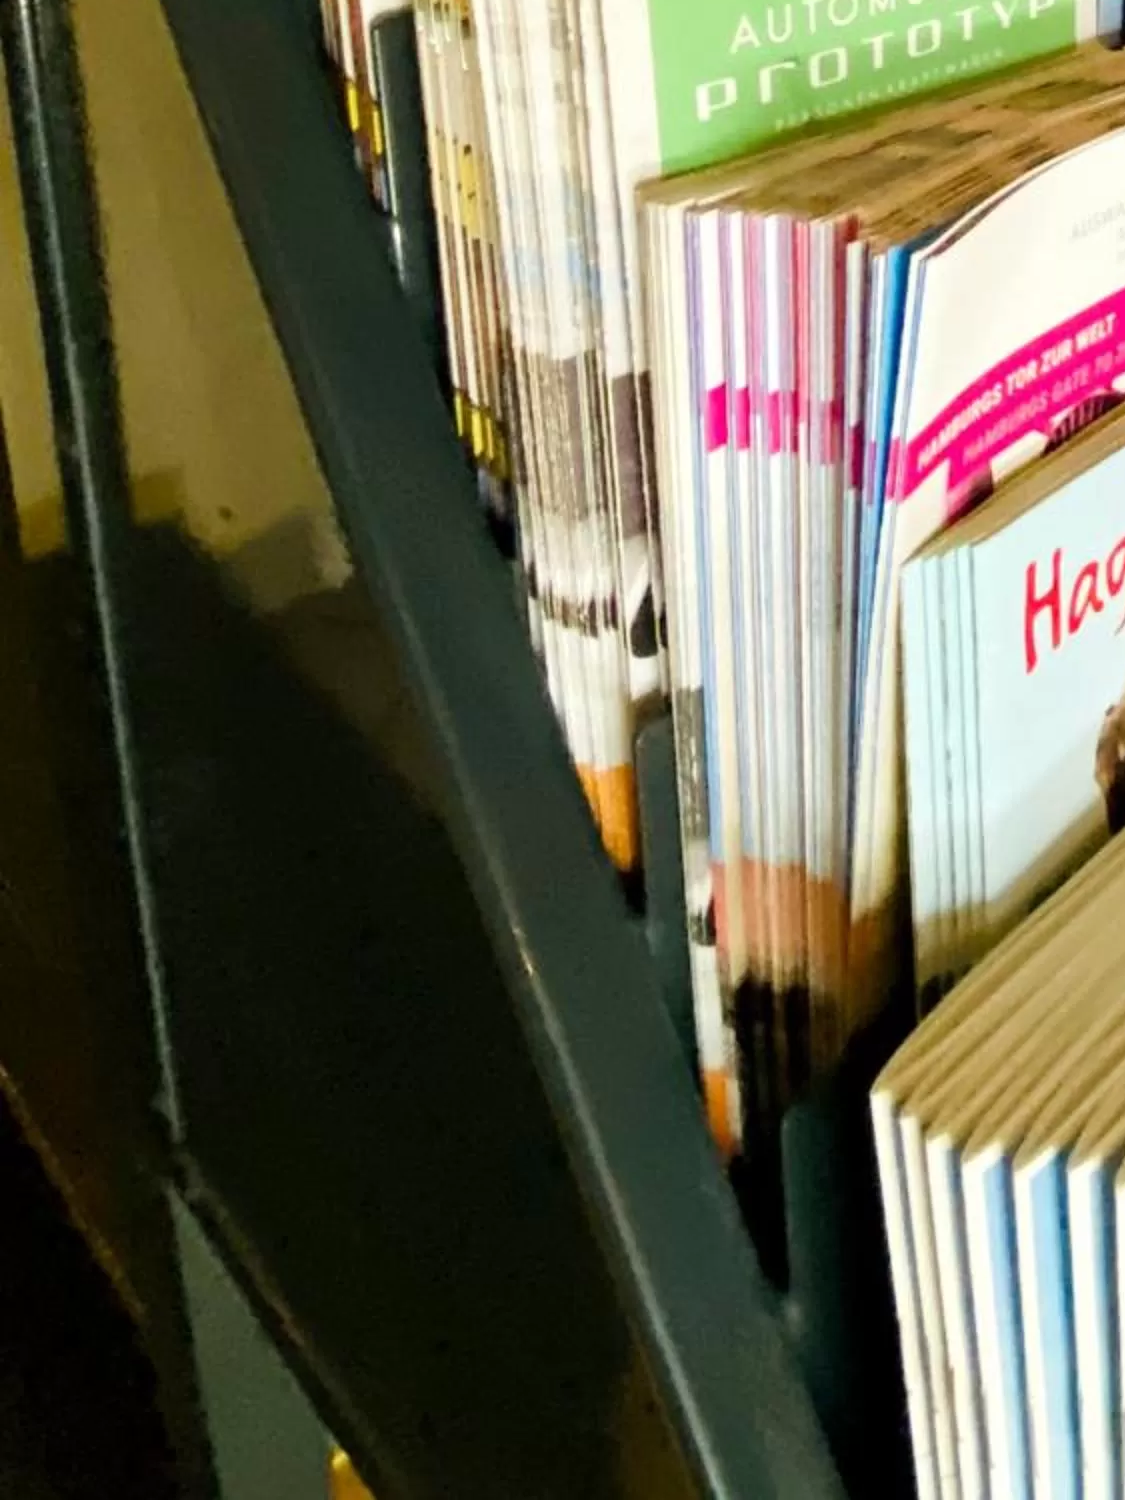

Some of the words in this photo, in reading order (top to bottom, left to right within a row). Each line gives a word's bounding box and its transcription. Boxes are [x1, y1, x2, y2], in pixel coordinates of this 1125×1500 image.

[916, 382, 1003, 472] HAMBURGS
[1005, 357, 1038, 397] TOR
[1040, 338, 1074, 373] ZUR
[1076, 311, 1118, 357] WELT
